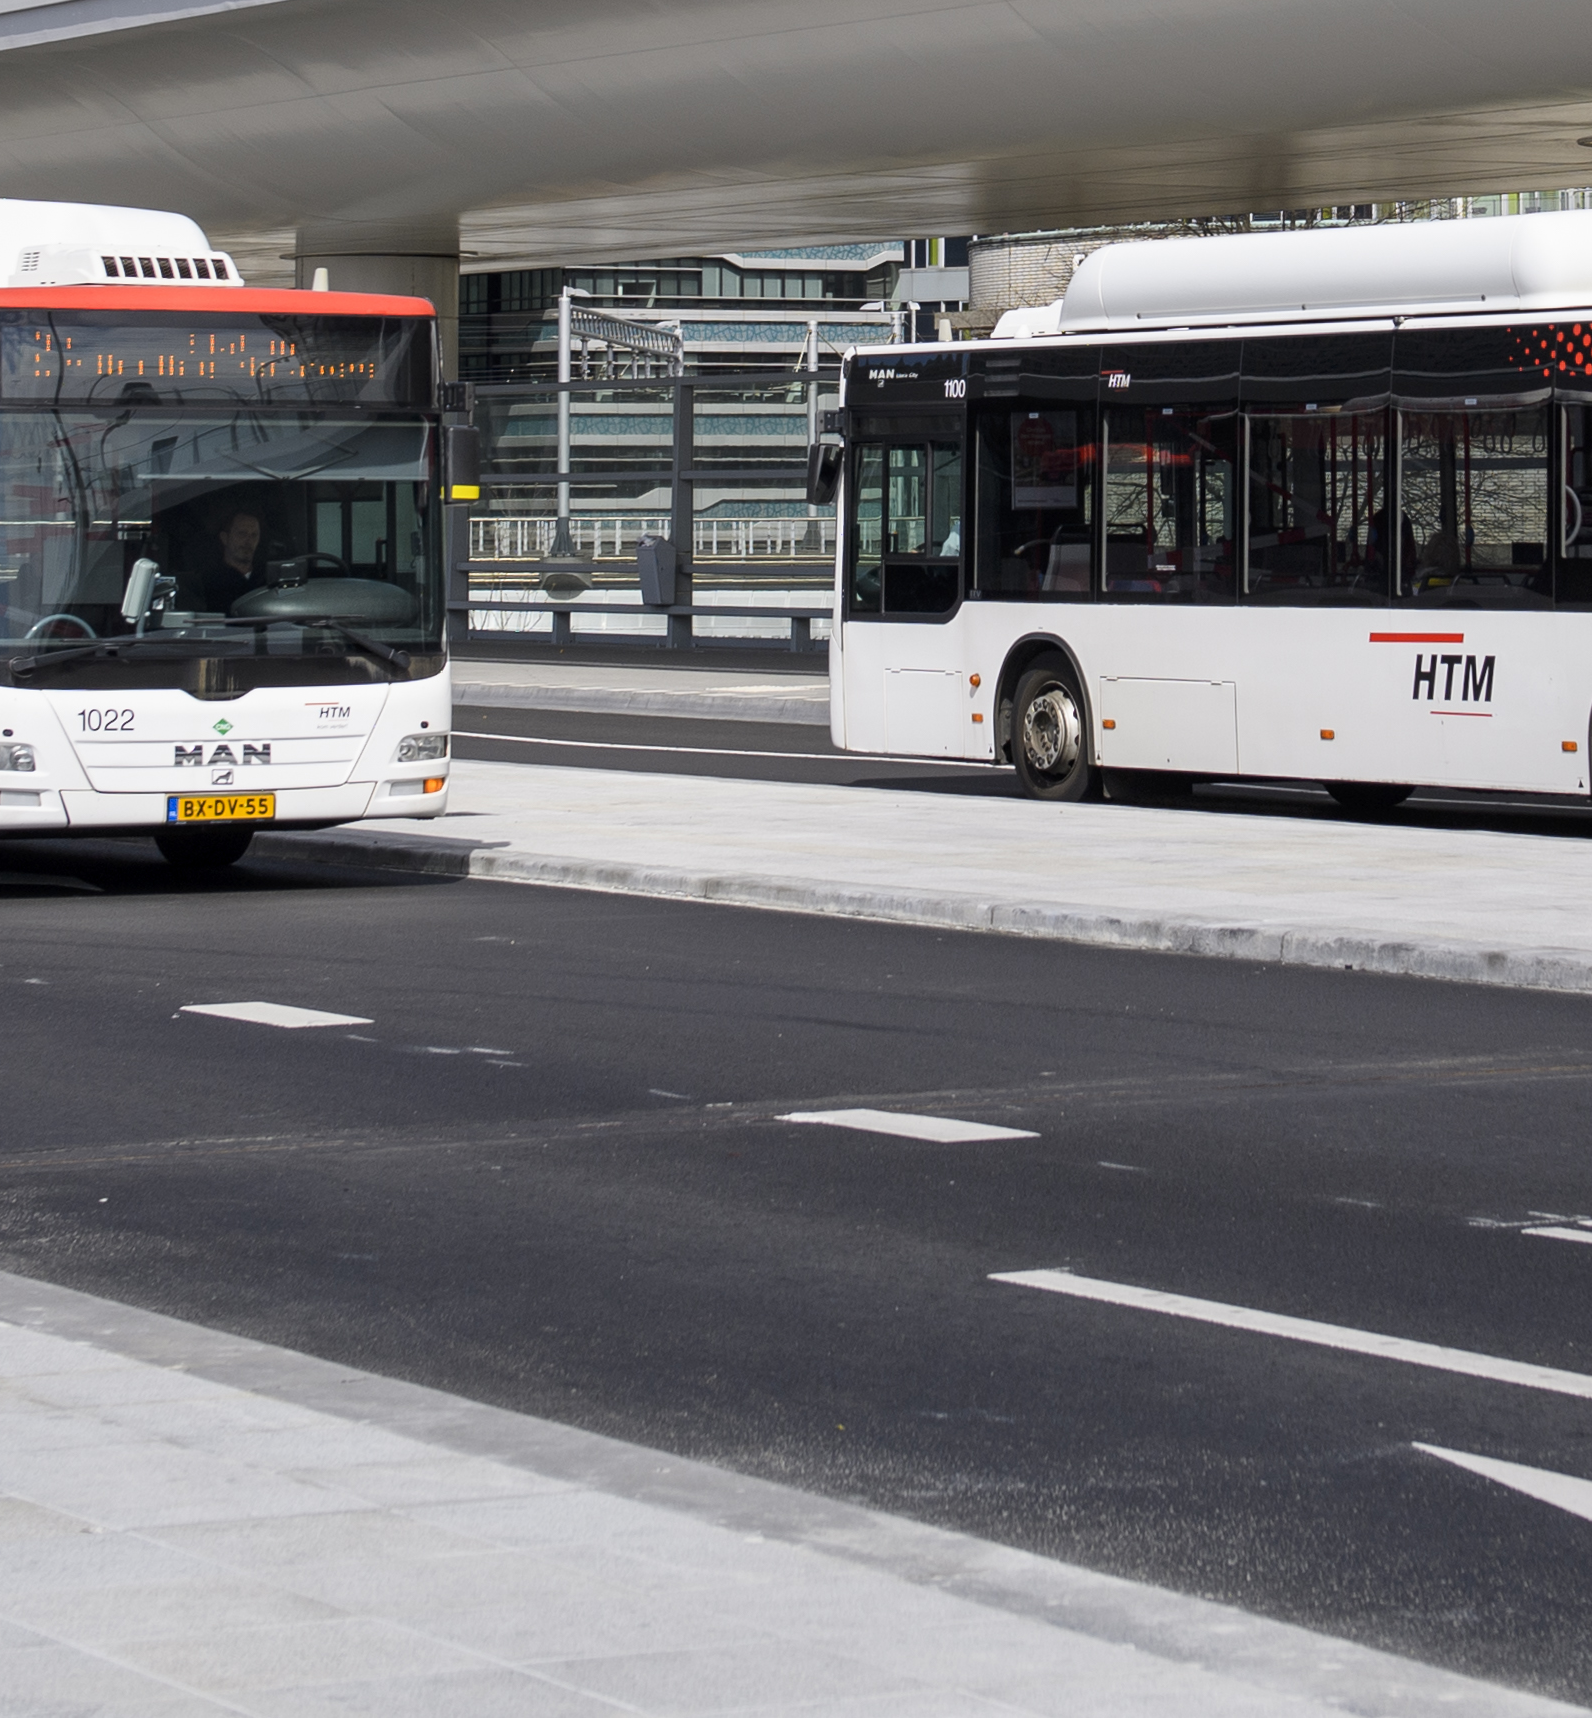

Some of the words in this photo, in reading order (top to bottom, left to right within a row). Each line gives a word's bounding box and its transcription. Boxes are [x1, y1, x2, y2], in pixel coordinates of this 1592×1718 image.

[869, 368, 895, 380] MAN
[1108, 373, 1131, 388] HTM
[944, 379, 966, 398] 1100
[1412, 654, 1496, 702] HTM
[78, 709, 135, 732] 1022
[319, 706, 351, 718] HTM
[174, 743, 271, 766] MAN
[184, 798, 269, 817] BX-DV-55
